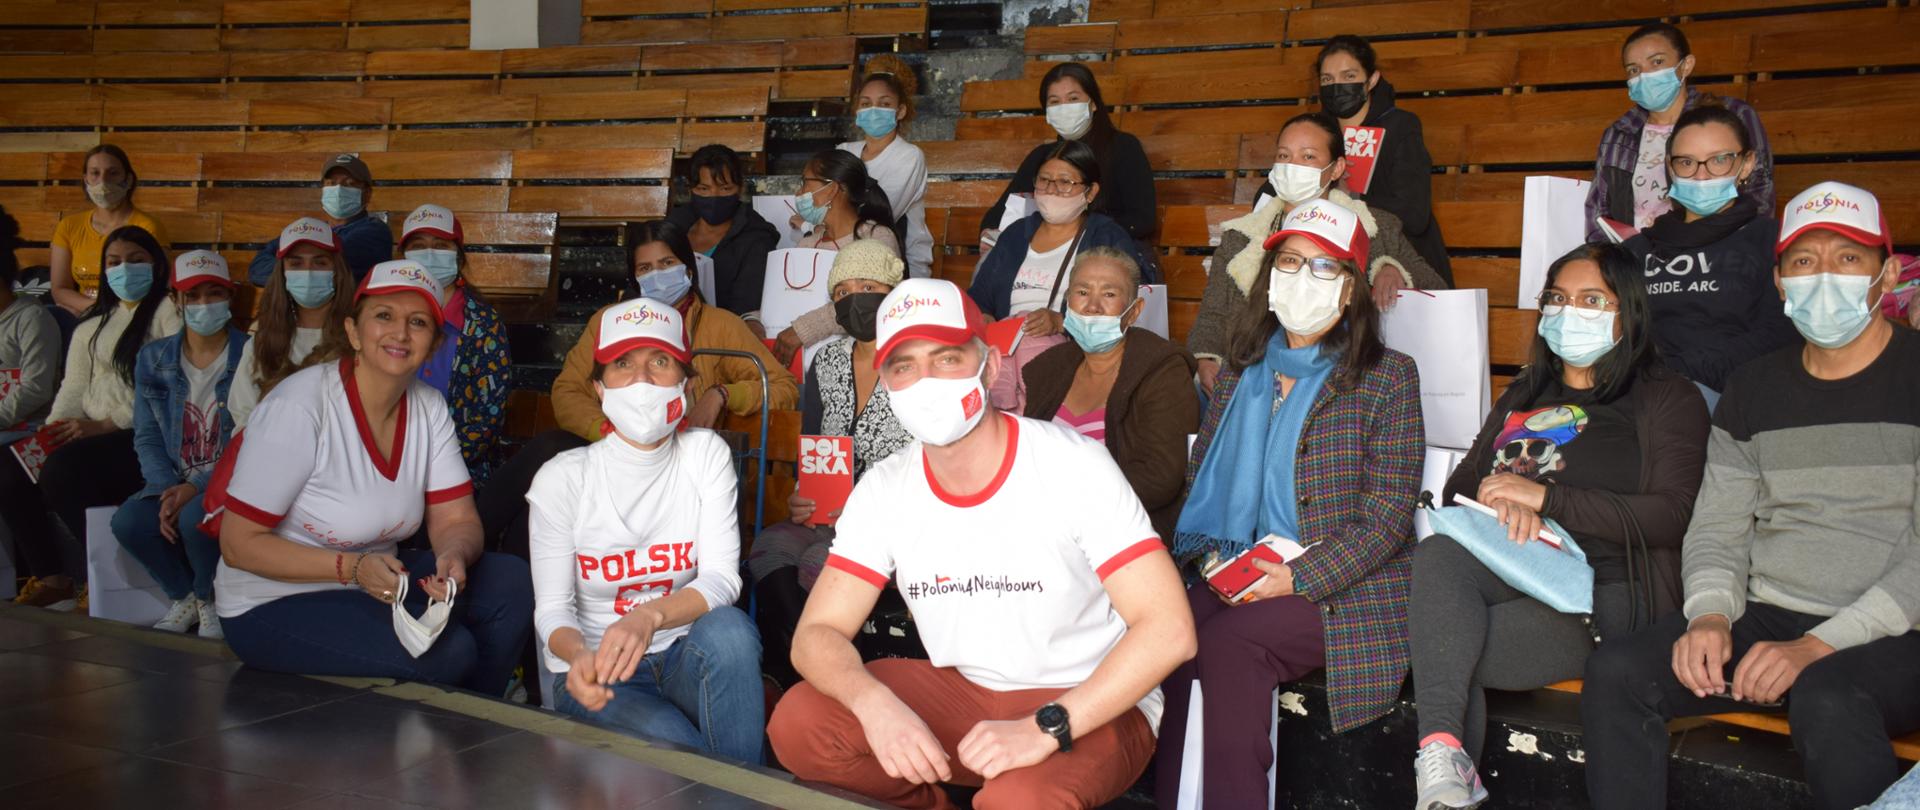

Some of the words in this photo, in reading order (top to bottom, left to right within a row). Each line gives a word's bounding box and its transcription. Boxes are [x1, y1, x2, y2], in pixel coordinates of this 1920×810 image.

[1344, 127, 1377, 144] POL
[1345, 141, 1374, 157] SKA
[1796, 197, 1860, 215] POLONIA
[391, 269, 436, 292] POLONIA
[616, 310, 671, 325] POLONIA
[883, 298, 941, 324] POLONIA
[801, 437, 848, 457] POL
[801, 455, 849, 475] SKA
[577, 541, 698, 582] POLSK
